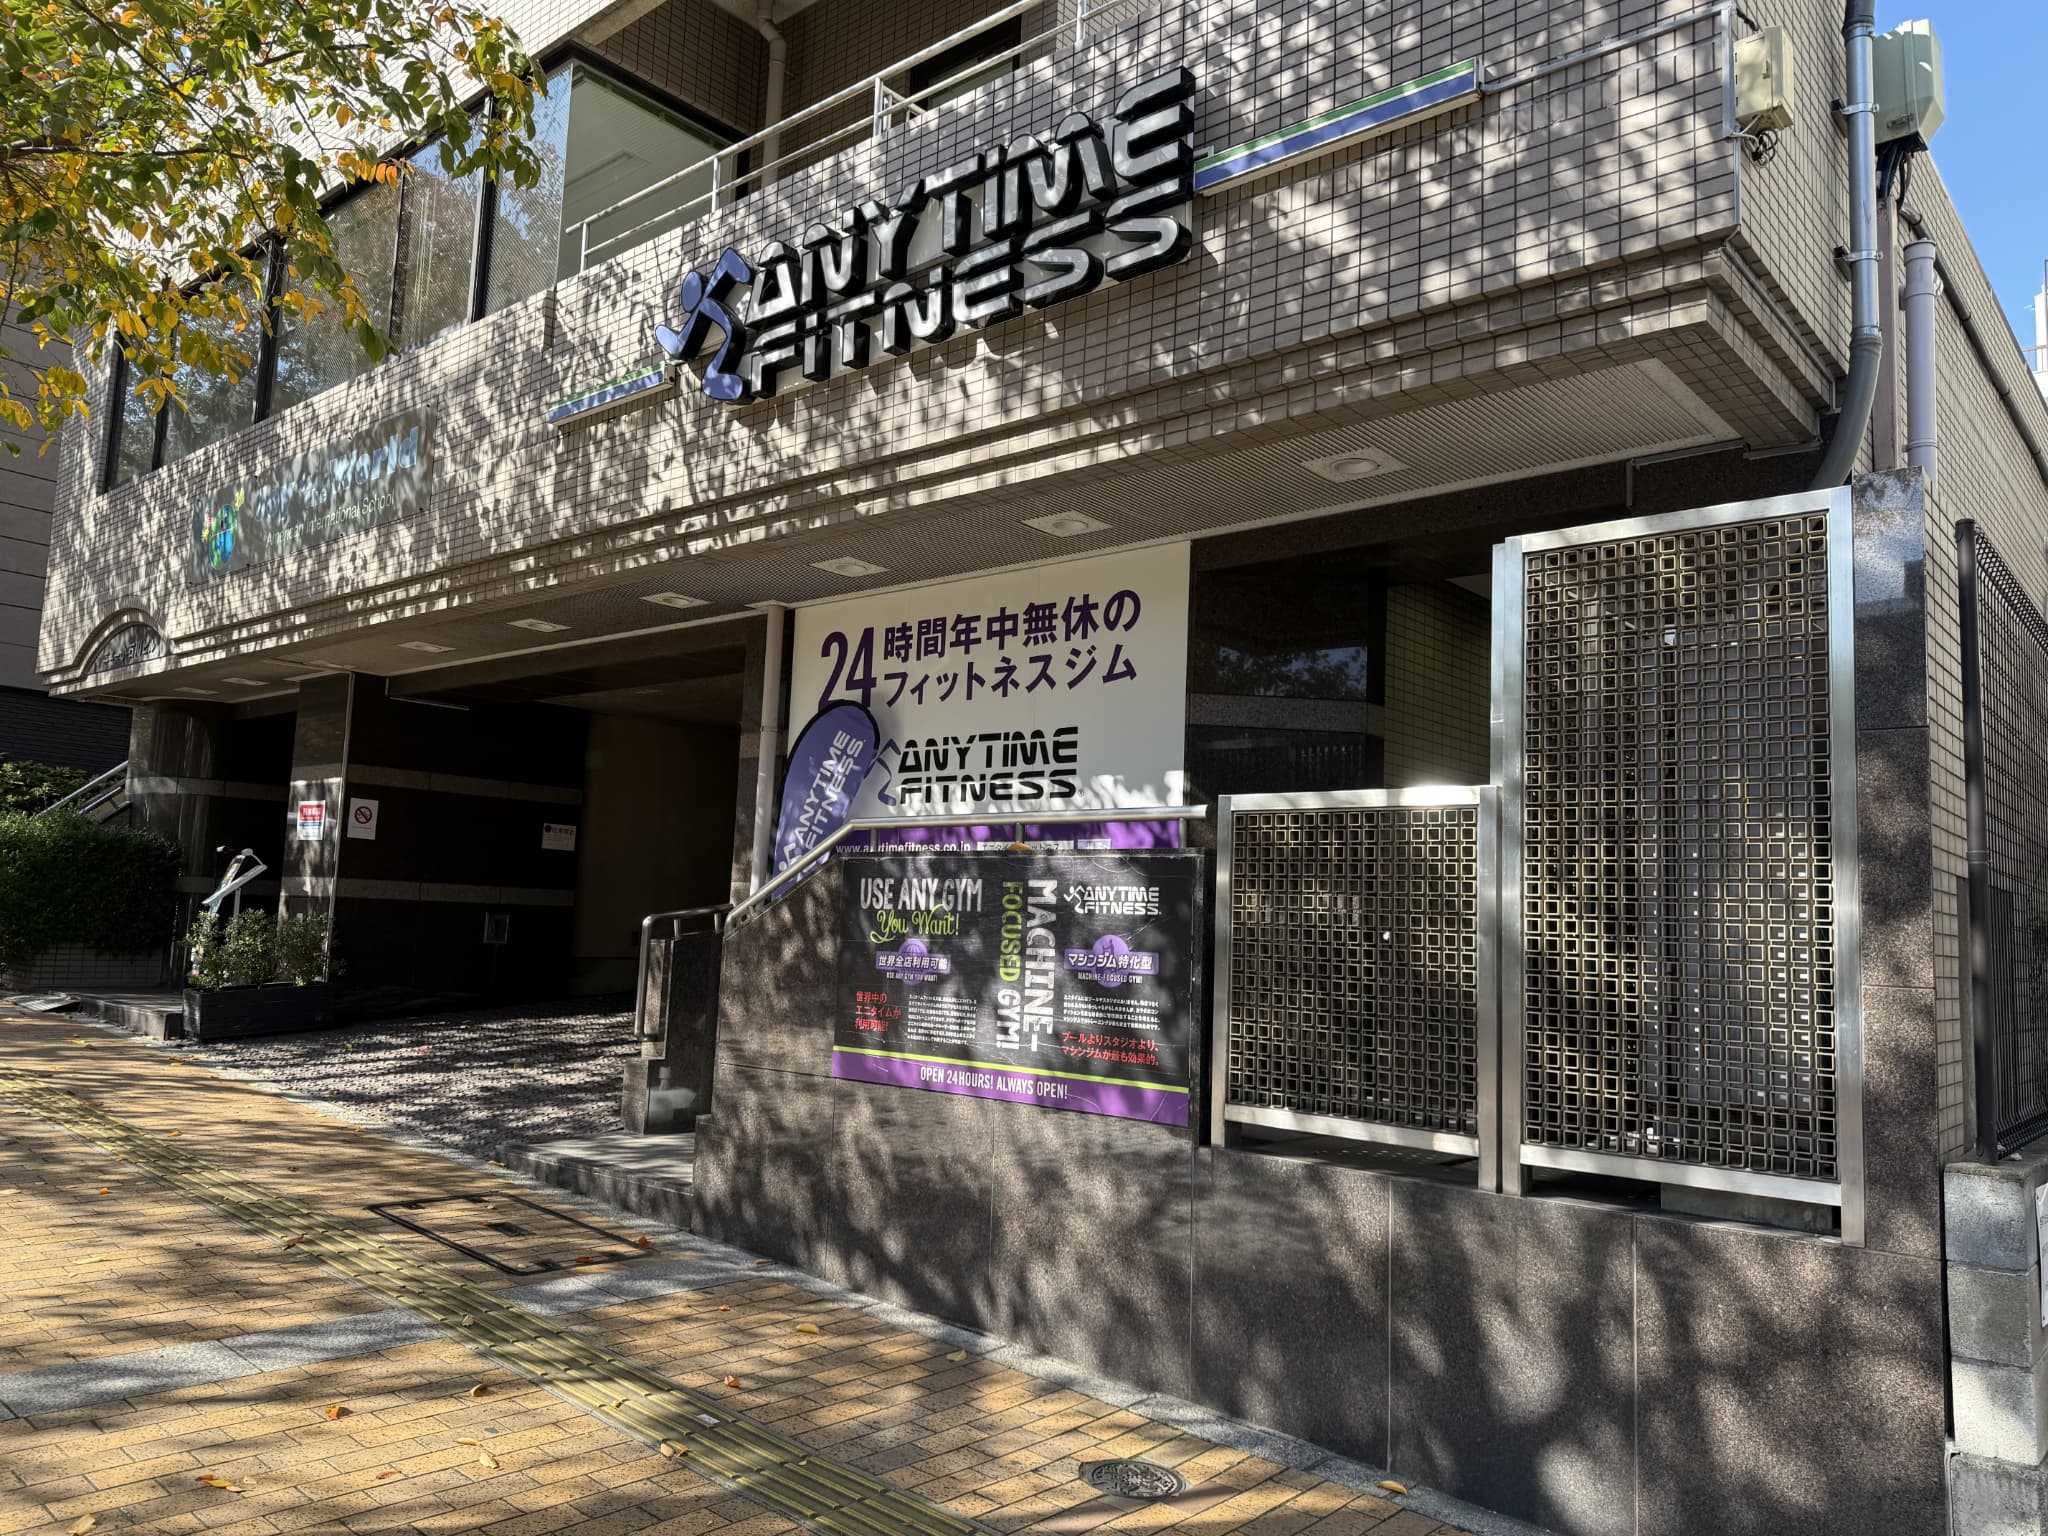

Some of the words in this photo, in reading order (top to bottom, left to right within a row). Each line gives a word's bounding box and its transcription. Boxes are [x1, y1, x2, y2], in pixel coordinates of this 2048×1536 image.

[745, 66, 1196, 328] ANYTIME
[751, 173, 1192, 399] FITNESS
[306, 502, 360, 534] International
[362, 487, 396, 515] School
[883, 589, 1142, 663] 時間年中無休の
[818, 627, 878, 712] 24
[883, 643, 1137, 707] フィットネスジム
[897, 726, 1079, 774] ANYTIME
[794, 730, 851, 845] ANYTIME
[805, 738, 864, 850] FITNESS
[899, 768, 1078, 805] FITNESS
[860, 878, 894, 910] USE
[898, 878, 938, 911] ANY
[942, 879, 983, 912] GYM
[1083, 886, 1160, 902] ANYTIME
[1084, 902, 1159, 915] FITNESS
[870, 909, 909, 943] You
[912, 903, 960, 936] Want!
[999, 881, 1023, 982] FOCUSED
[879, 955, 948, 970] 世界全店利用可能
[1068, 951, 1153, 970] マシンジム特化型
[1077, 972, 1127, 983] MACHINE-FOCUSED
[855, 990, 888, 1003] 世界中の
[855, 1005, 902, 1019] エニタイムが
[996, 988, 1022, 1050] GYM!
[920, 1066, 945, 1083] OPEN
[946, 1070, 994, 1089] 24HOURS!
[996, 1076, 1034, 1095] ALWAYS
[1036, 1081, 1068, 1099] OPEN!
